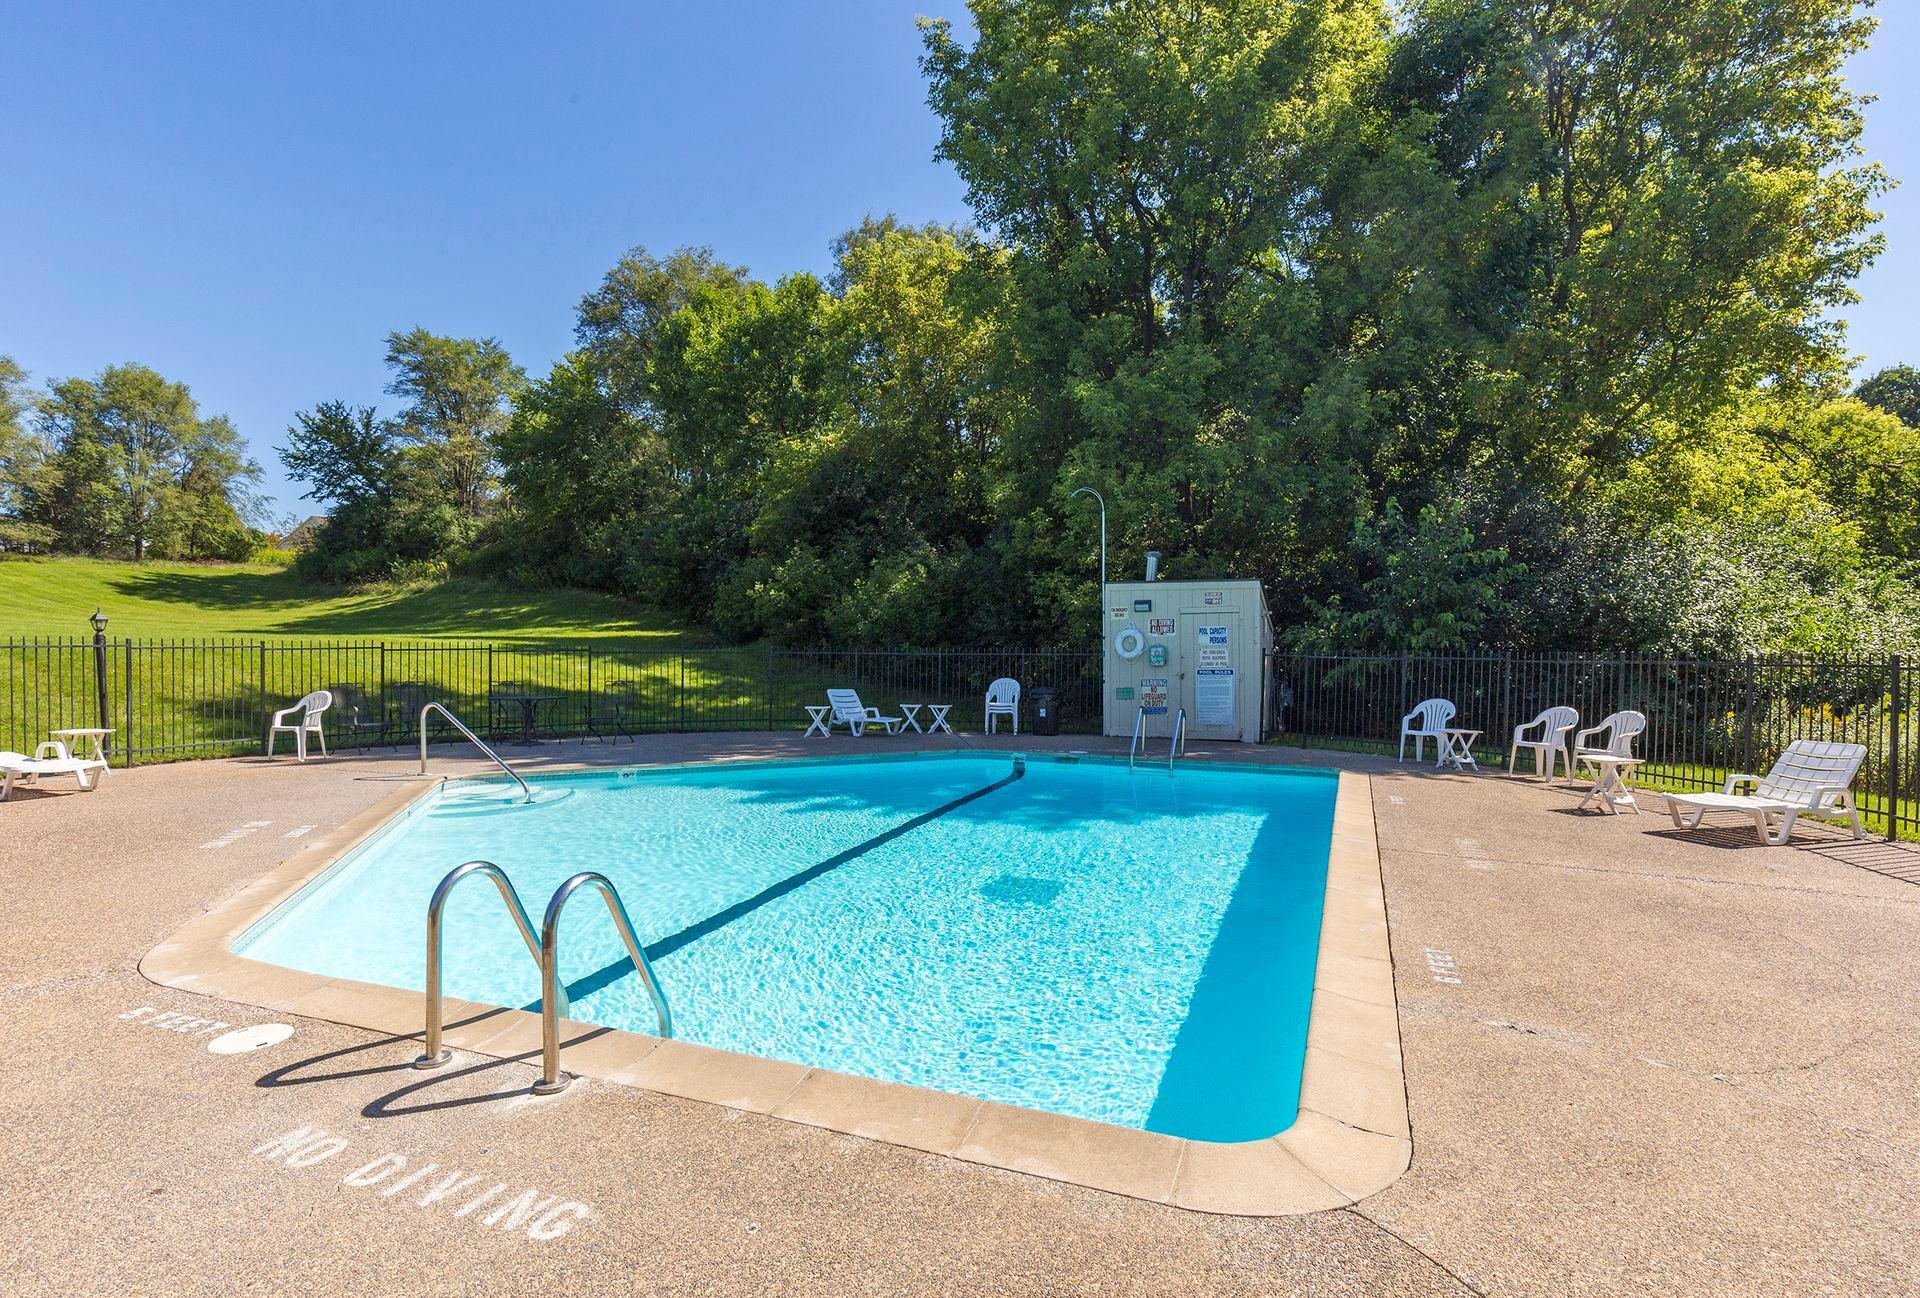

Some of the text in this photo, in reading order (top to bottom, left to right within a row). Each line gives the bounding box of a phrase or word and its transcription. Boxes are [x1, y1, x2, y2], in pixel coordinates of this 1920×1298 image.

[1199, 627, 1227, 635] POOL CAPACITY
[1209, 636, 1228, 644] PERSONS
[139, 1010, 232, 1037] FEET
[251, 1126, 589, 1240] NO DIVING
